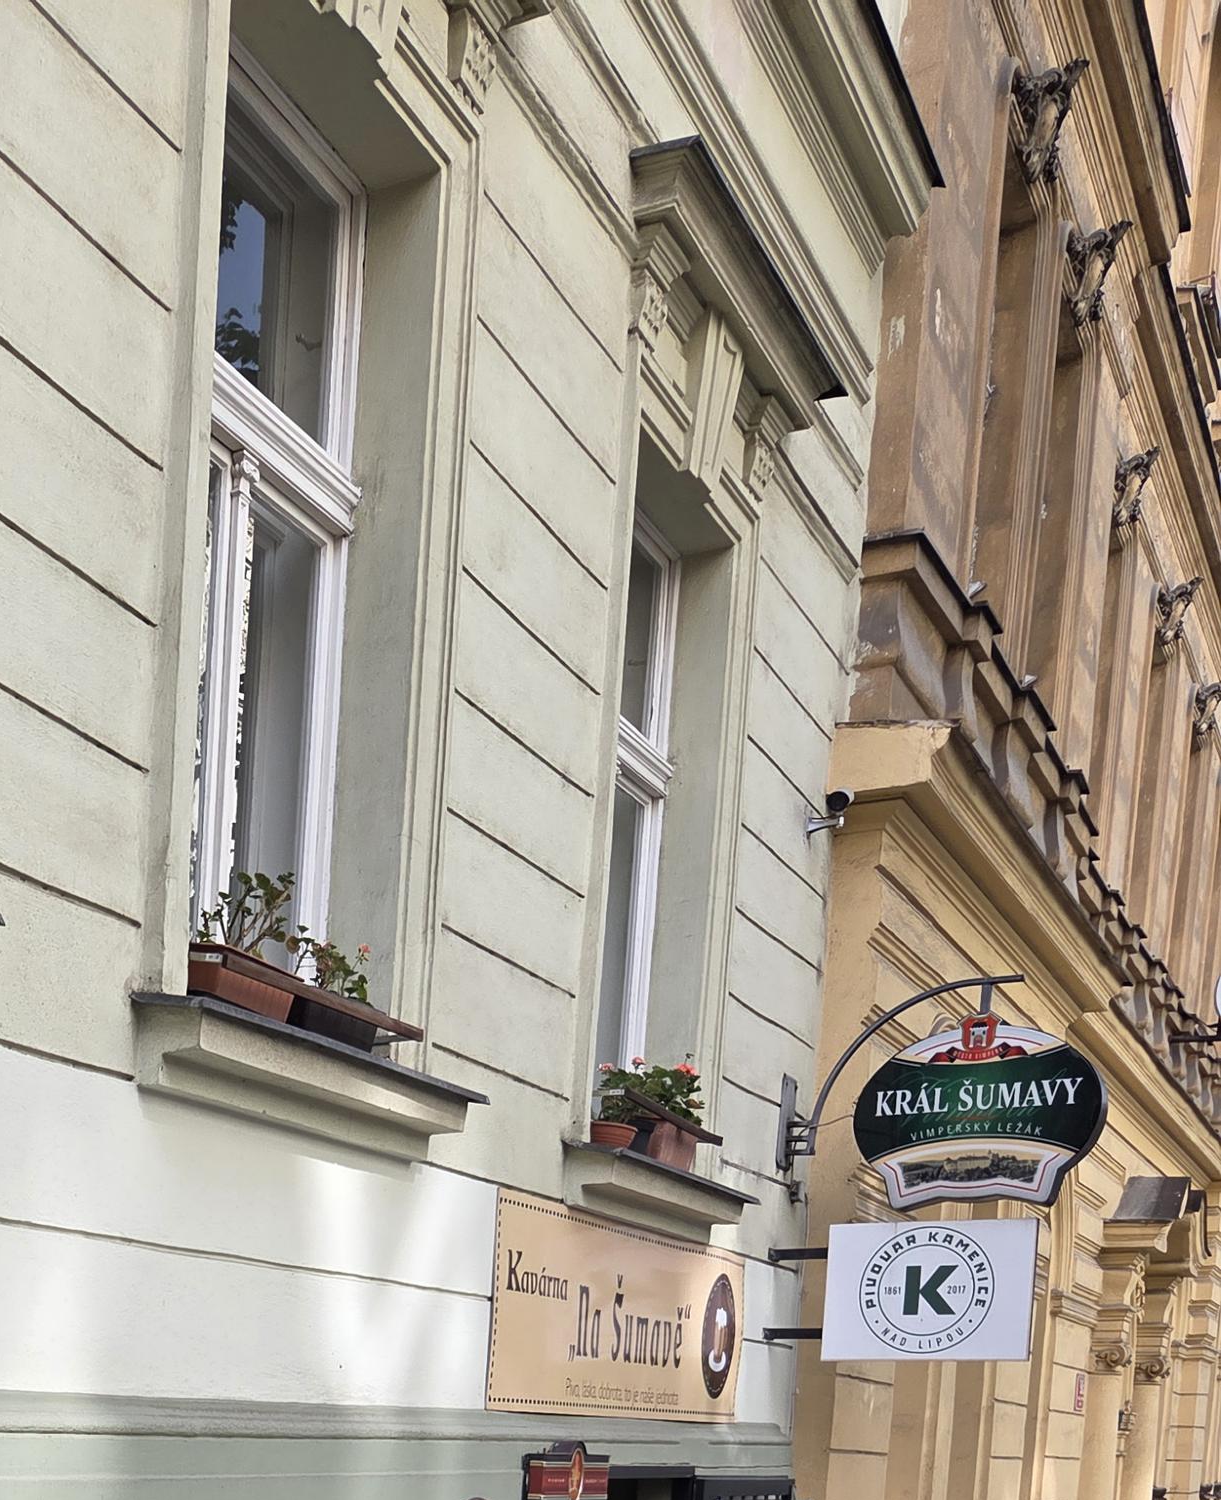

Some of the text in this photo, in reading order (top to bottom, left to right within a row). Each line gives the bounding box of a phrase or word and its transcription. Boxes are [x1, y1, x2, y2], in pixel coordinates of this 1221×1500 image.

[875, 1077, 1084, 1117] KRÁL ŠUMAVY
[910, 1121, 1044, 1141] VIMPERSKÝ LEŽÁK
[506, 1248, 568, 1301] Kavárna
[928, 1231, 989, 1309] KAMENICE
[884, 1286, 901, 1296] 1861
[902, 1264, 960, 1316] K
[946, 1285, 967, 1296] 2017
[881, 1327, 964, 1350] NAD LIPOU
